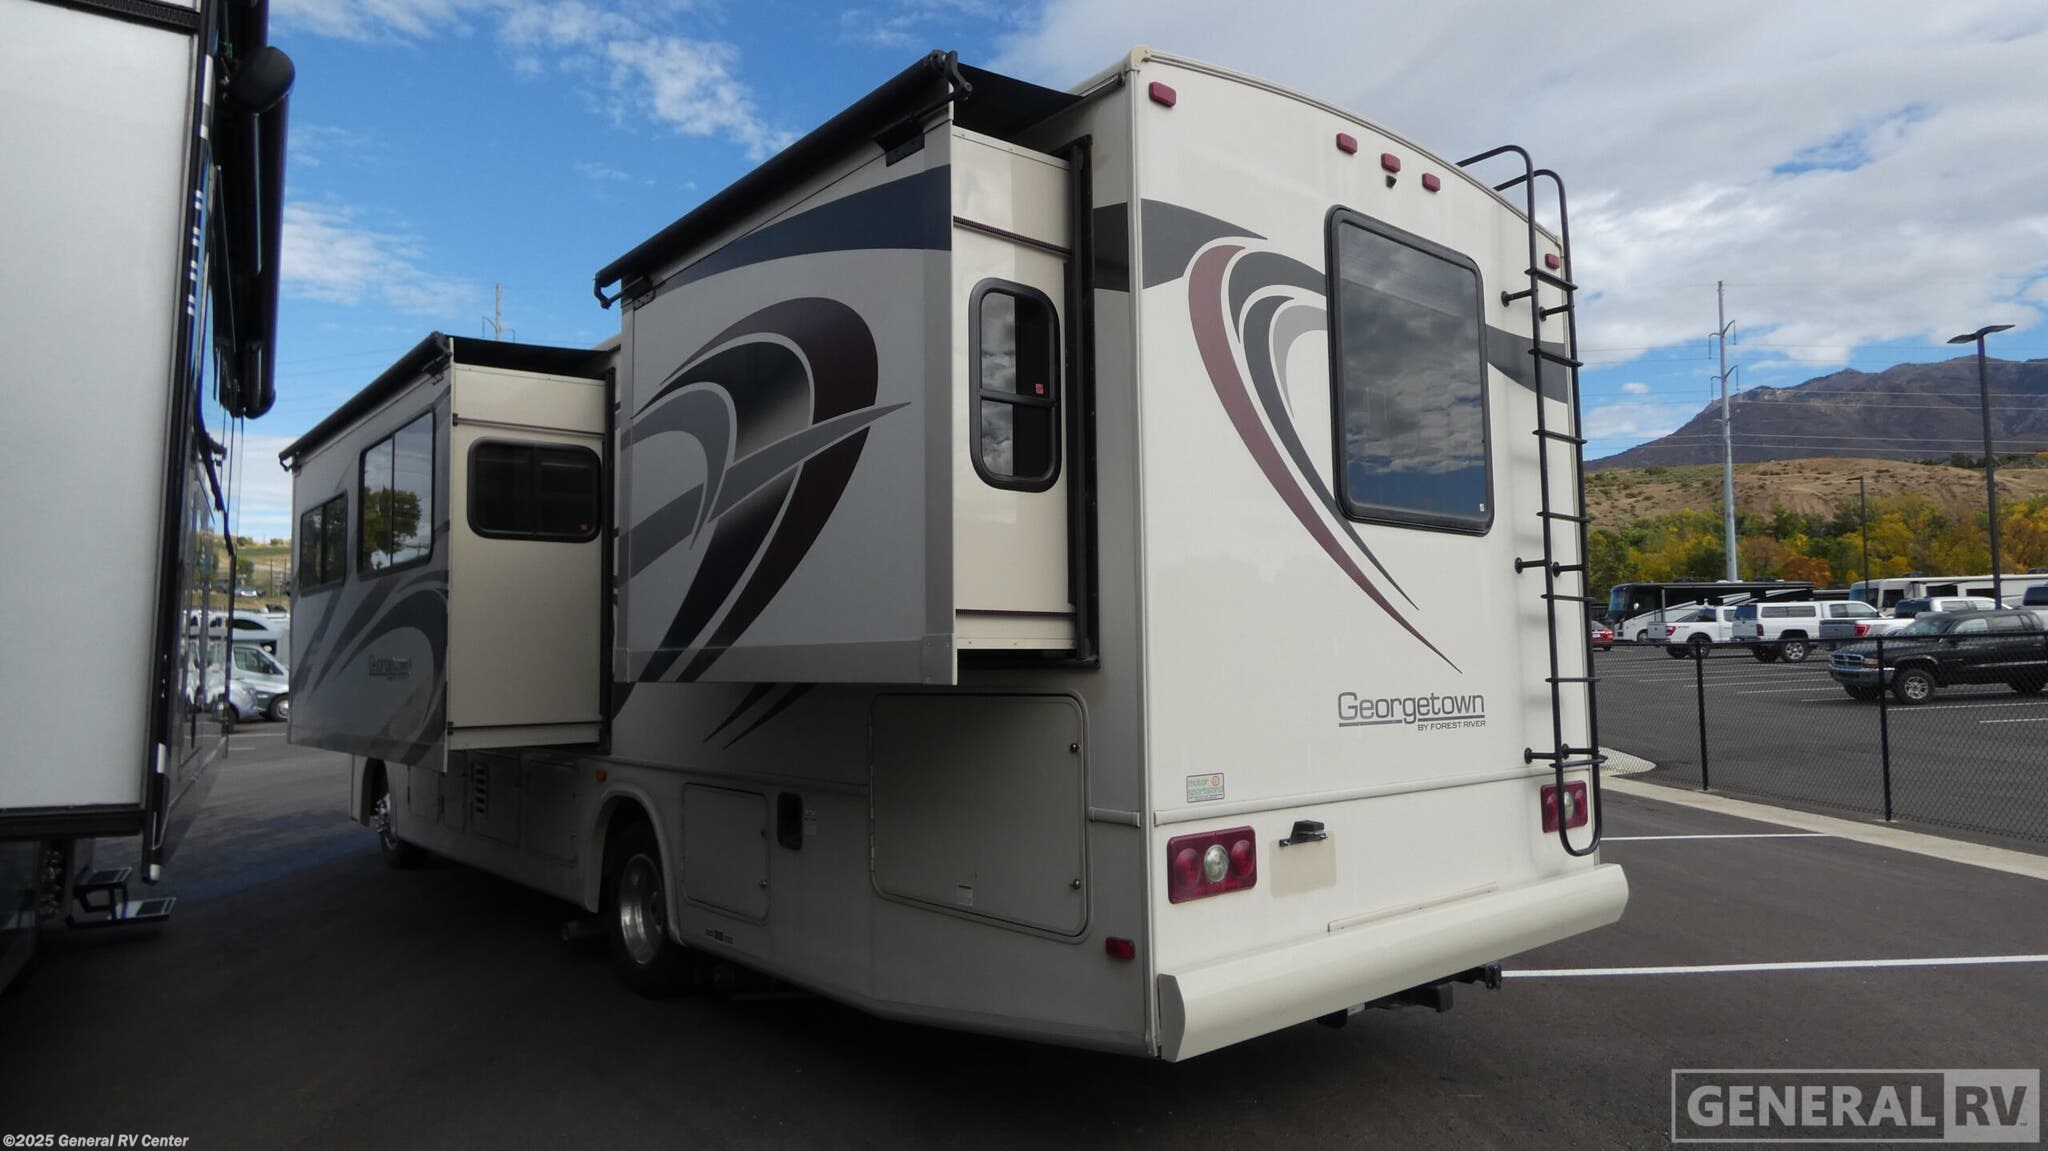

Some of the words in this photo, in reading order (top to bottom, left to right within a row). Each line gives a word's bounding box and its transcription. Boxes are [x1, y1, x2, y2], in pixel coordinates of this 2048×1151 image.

[1338, 692, 1485, 724] Georgetown
[1430, 722, 1461, 730] FOREST
[1463, 720, 1486, 728] RIVER
